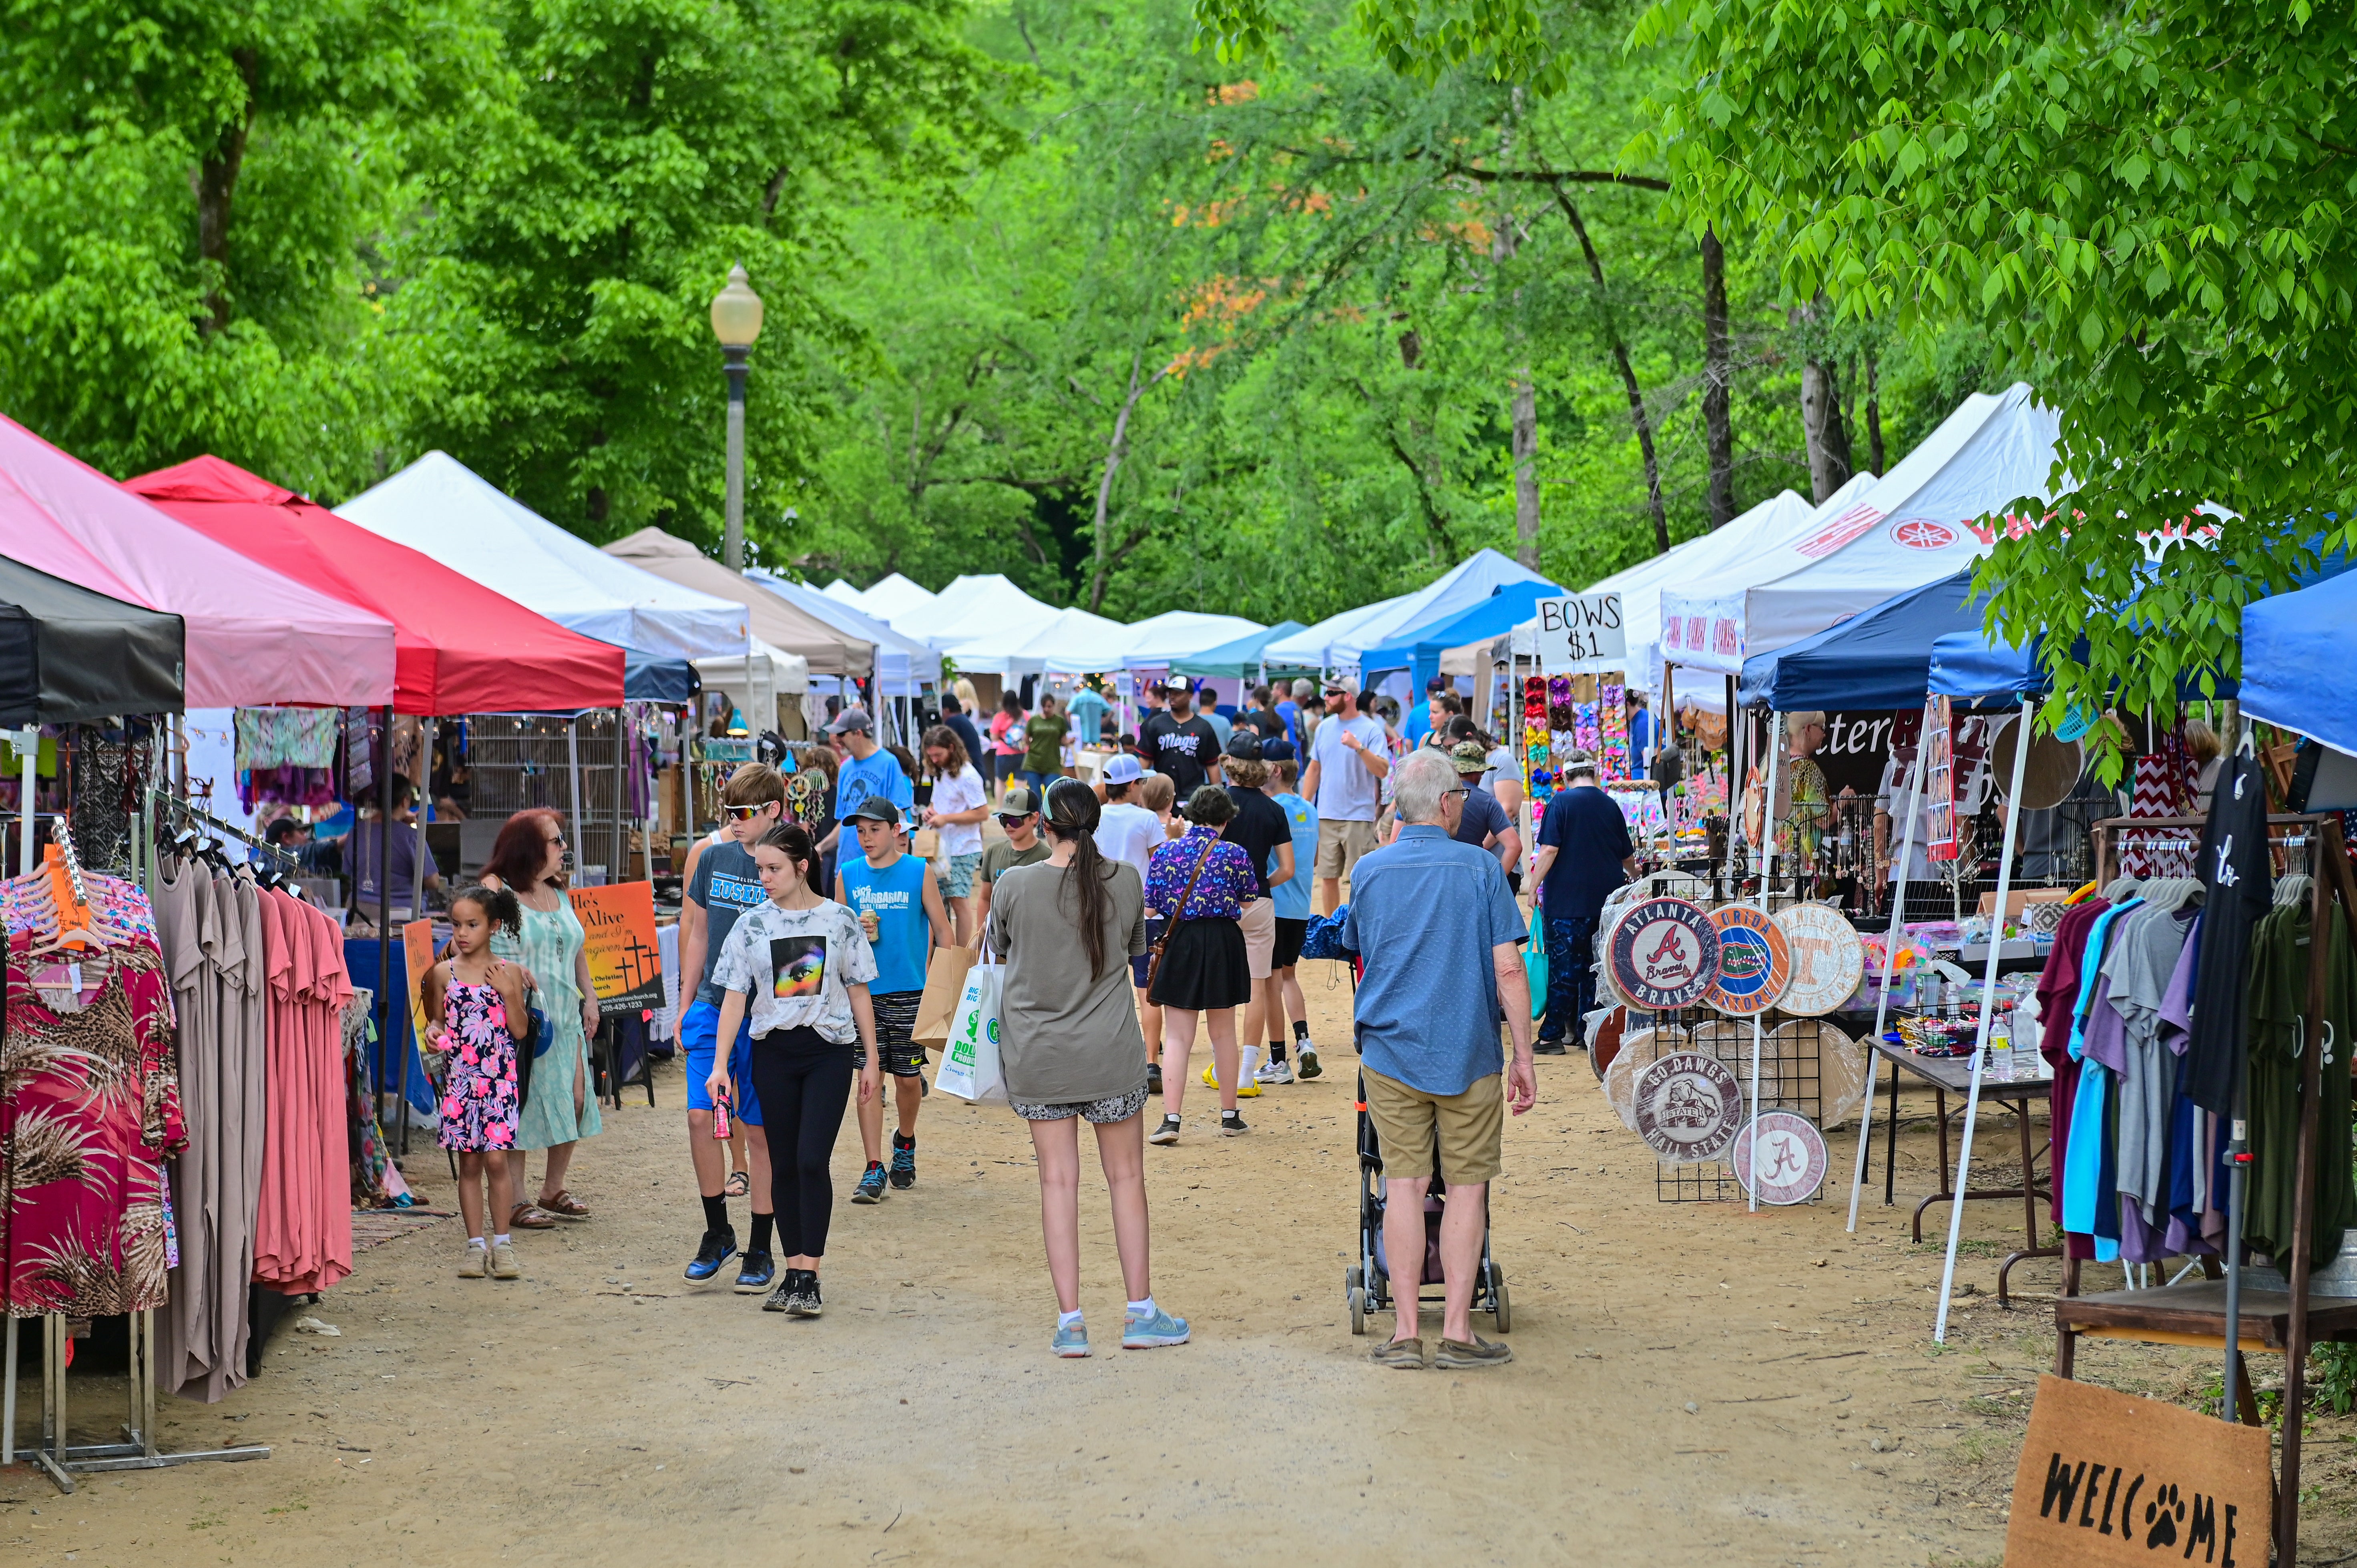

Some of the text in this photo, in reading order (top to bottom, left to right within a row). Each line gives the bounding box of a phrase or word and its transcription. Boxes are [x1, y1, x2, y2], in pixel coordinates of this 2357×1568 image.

[1542, 596, 1620, 632] BOWS
[1568, 630, 1604, 661] $1
[1157, 732, 1200, 752] Magic
[860, 770, 881, 785] TREES
[571, 892, 599, 909] He's
[709, 877, 769, 905] HUSKIE
[859, 891, 909, 904] BARBARIAN
[585, 909, 625, 928] Alive
[1625, 903, 1701, 935] ATLANTA
[1717, 910, 1771, 936] ORIDA
[589, 925, 633, 940] and I'm
[582, 937, 627, 961] orgiven!
[1647, 924, 1686, 964] A
[1646, 962, 1682, 982] Braves
[966, 994, 978, 1002] BIG
[968, 987, 979, 995] BIG
[1635, 979, 1706, 1005] BRAVES
[1710, 987, 1776, 1010] GATORS
[601, 1001, 643, 1012] 205-426-1233
[1648, 1056, 1728, 1086] GO DAWGS
[1668, 1108, 1696, 1117] STATE
[1690, 1120, 1736, 1158] STATE
[1764, 1137, 1801, 1180] A
[1157, 1322, 1175, 1333] HOKA
